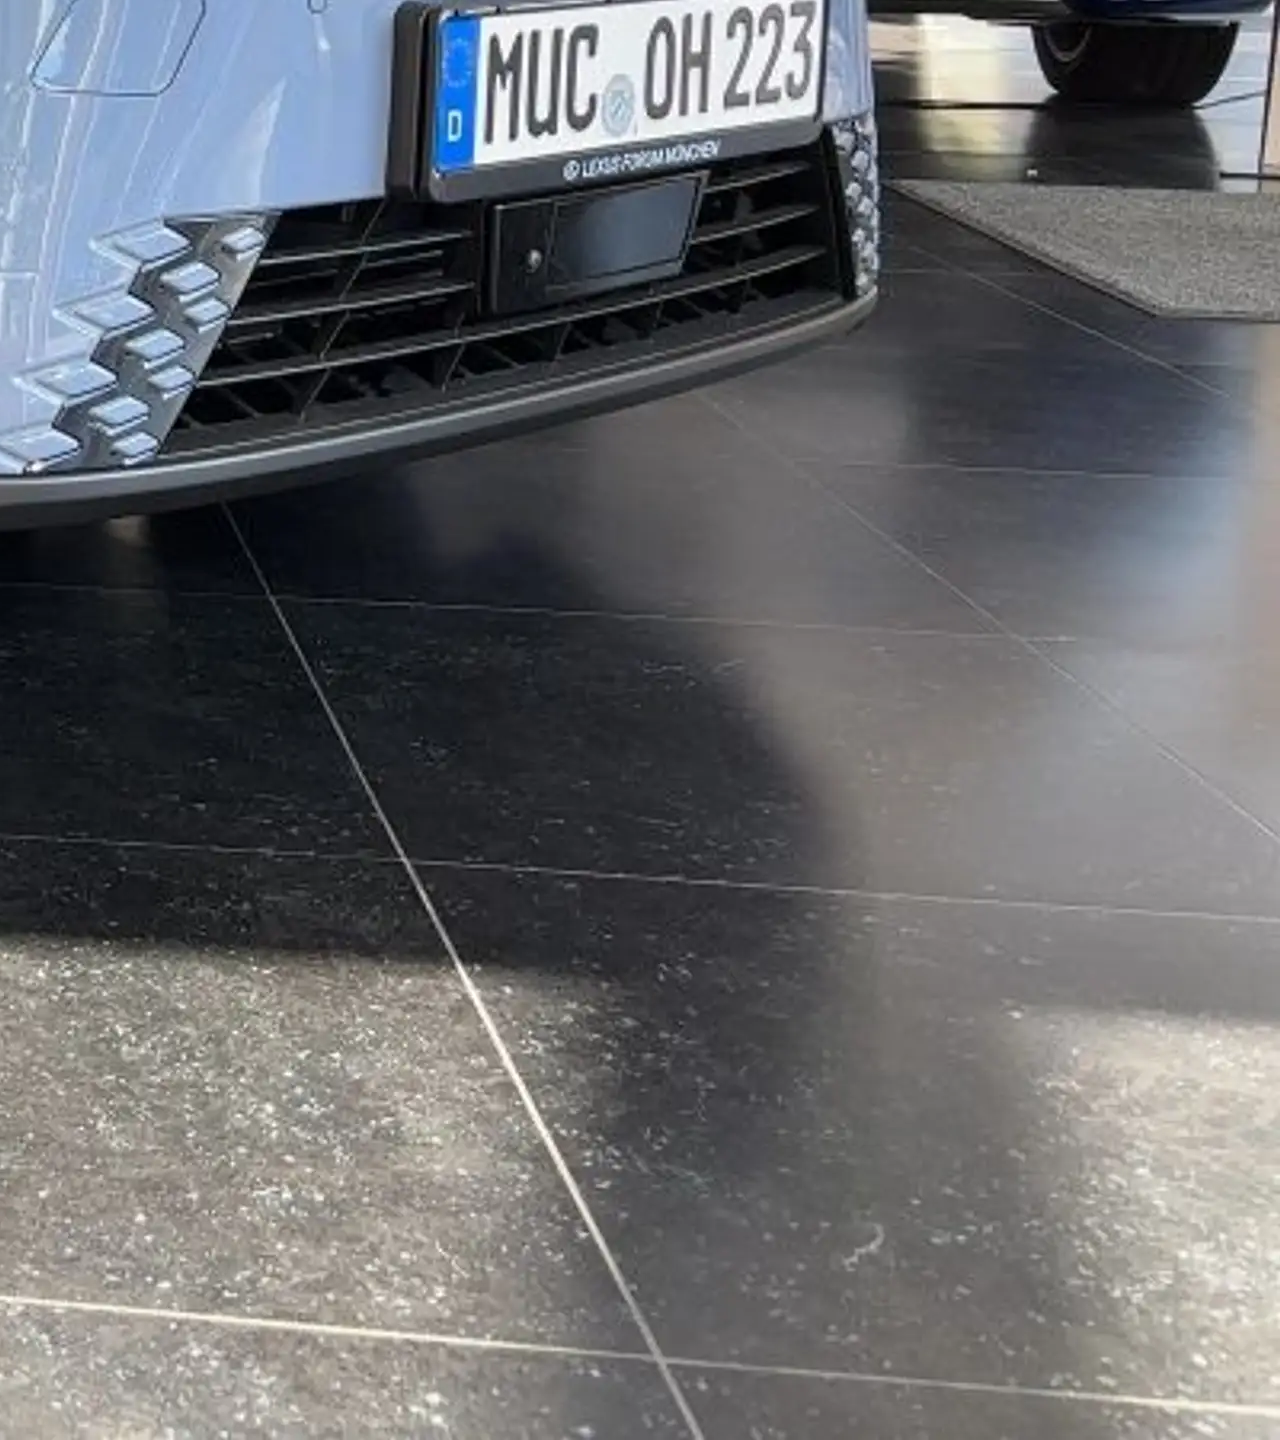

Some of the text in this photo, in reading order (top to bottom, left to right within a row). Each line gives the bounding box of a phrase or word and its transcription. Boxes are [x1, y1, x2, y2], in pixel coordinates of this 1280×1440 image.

[484, 24, 598, 145] MUC
[644, 10, 712, 120] OH
[723, 0, 817, 110] 223
[447, 109, 463, 142] D
